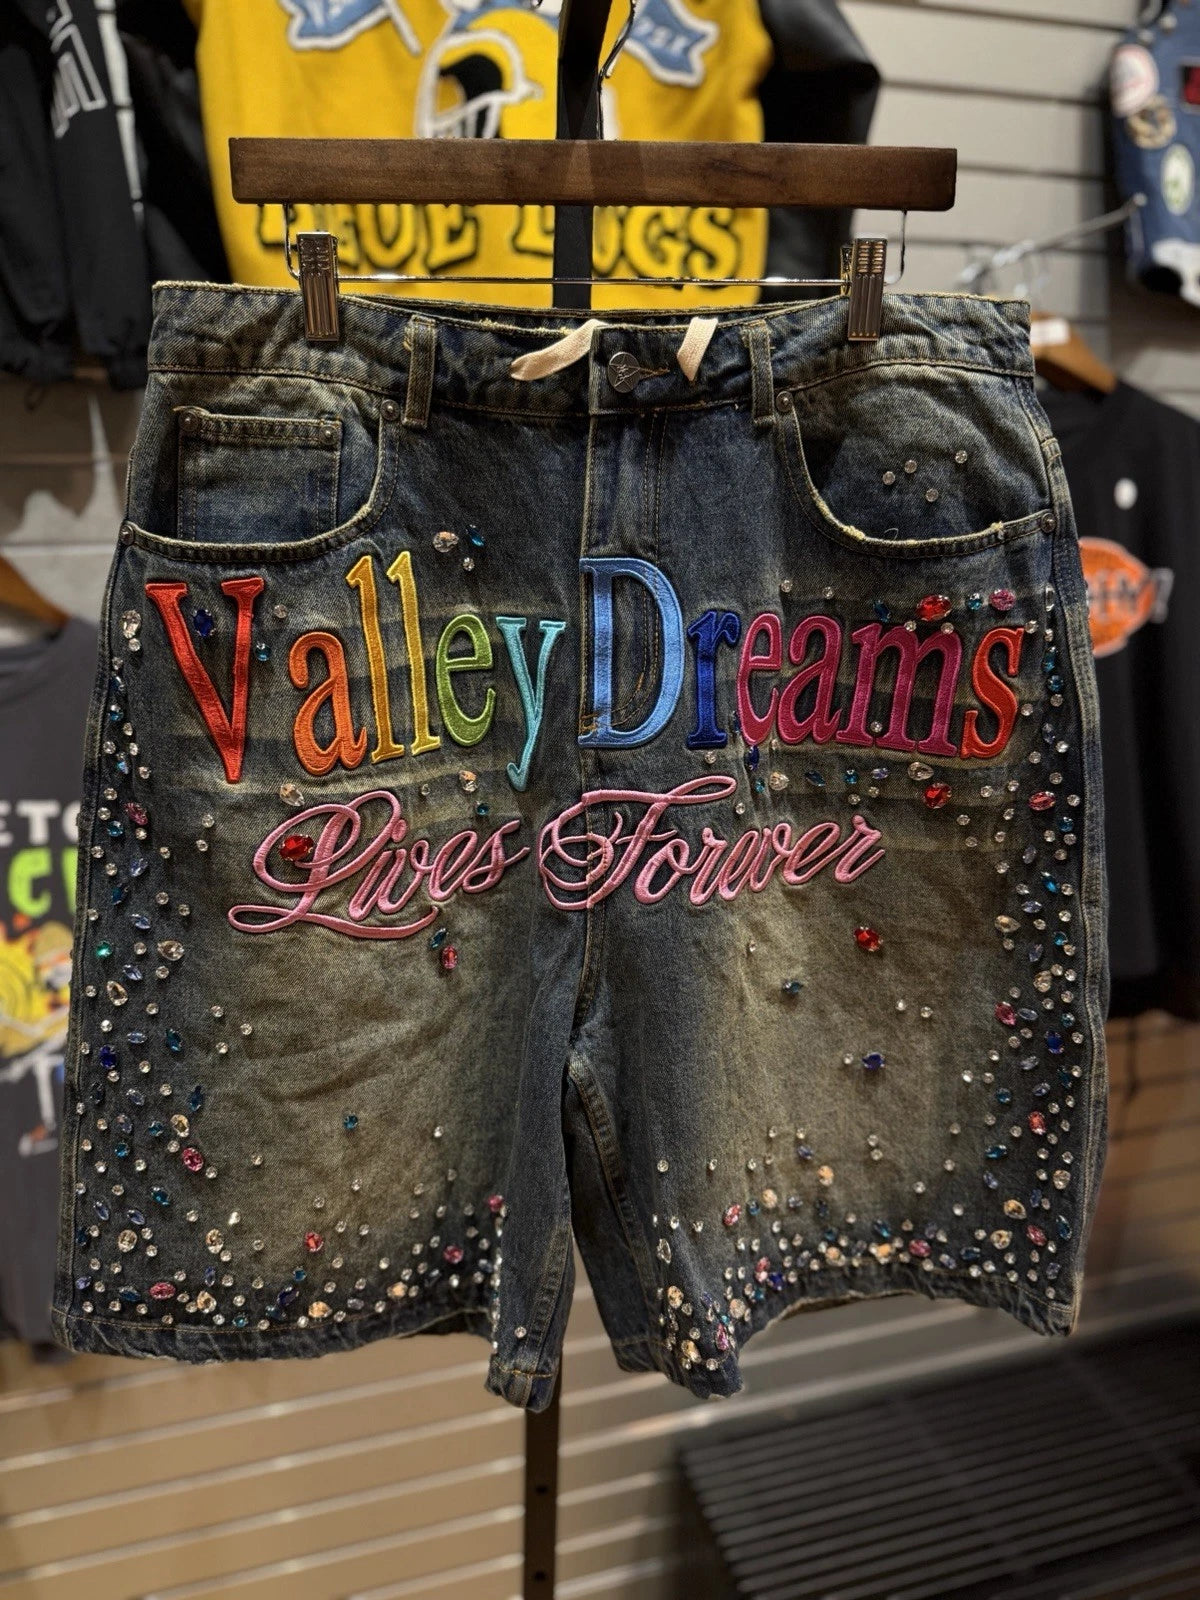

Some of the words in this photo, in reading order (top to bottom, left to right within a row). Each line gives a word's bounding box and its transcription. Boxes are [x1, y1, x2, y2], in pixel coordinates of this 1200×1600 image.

[145, 550, 567, 791] Valley
[577, 556, 1025, 759] Dreams
[227, 789, 531, 939] Lives
[537, 774, 886, 911] Forever
